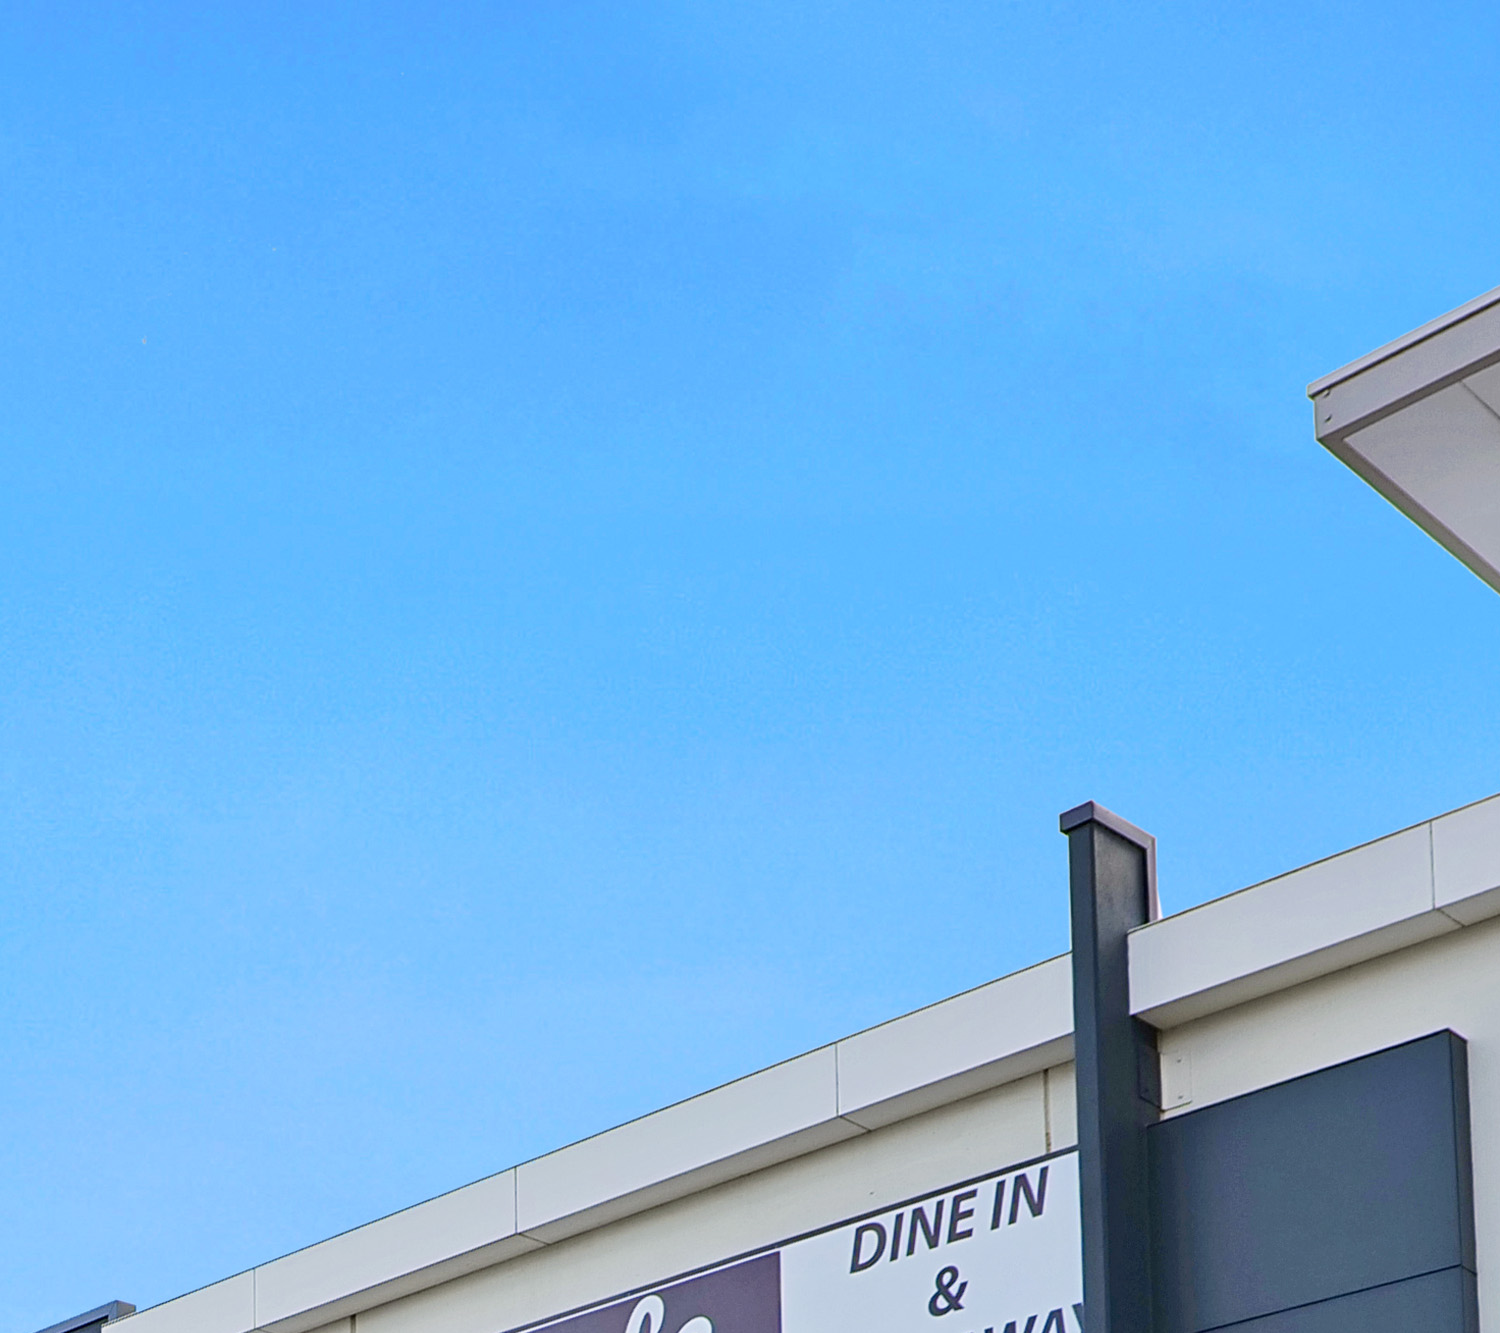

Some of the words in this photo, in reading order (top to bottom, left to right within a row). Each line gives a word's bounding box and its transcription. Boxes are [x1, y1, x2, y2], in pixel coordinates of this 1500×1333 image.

[848, 1188, 974, 1276] DINE
[989, 1164, 1050, 1231] IN
[927, 1264, 969, 1317] &
